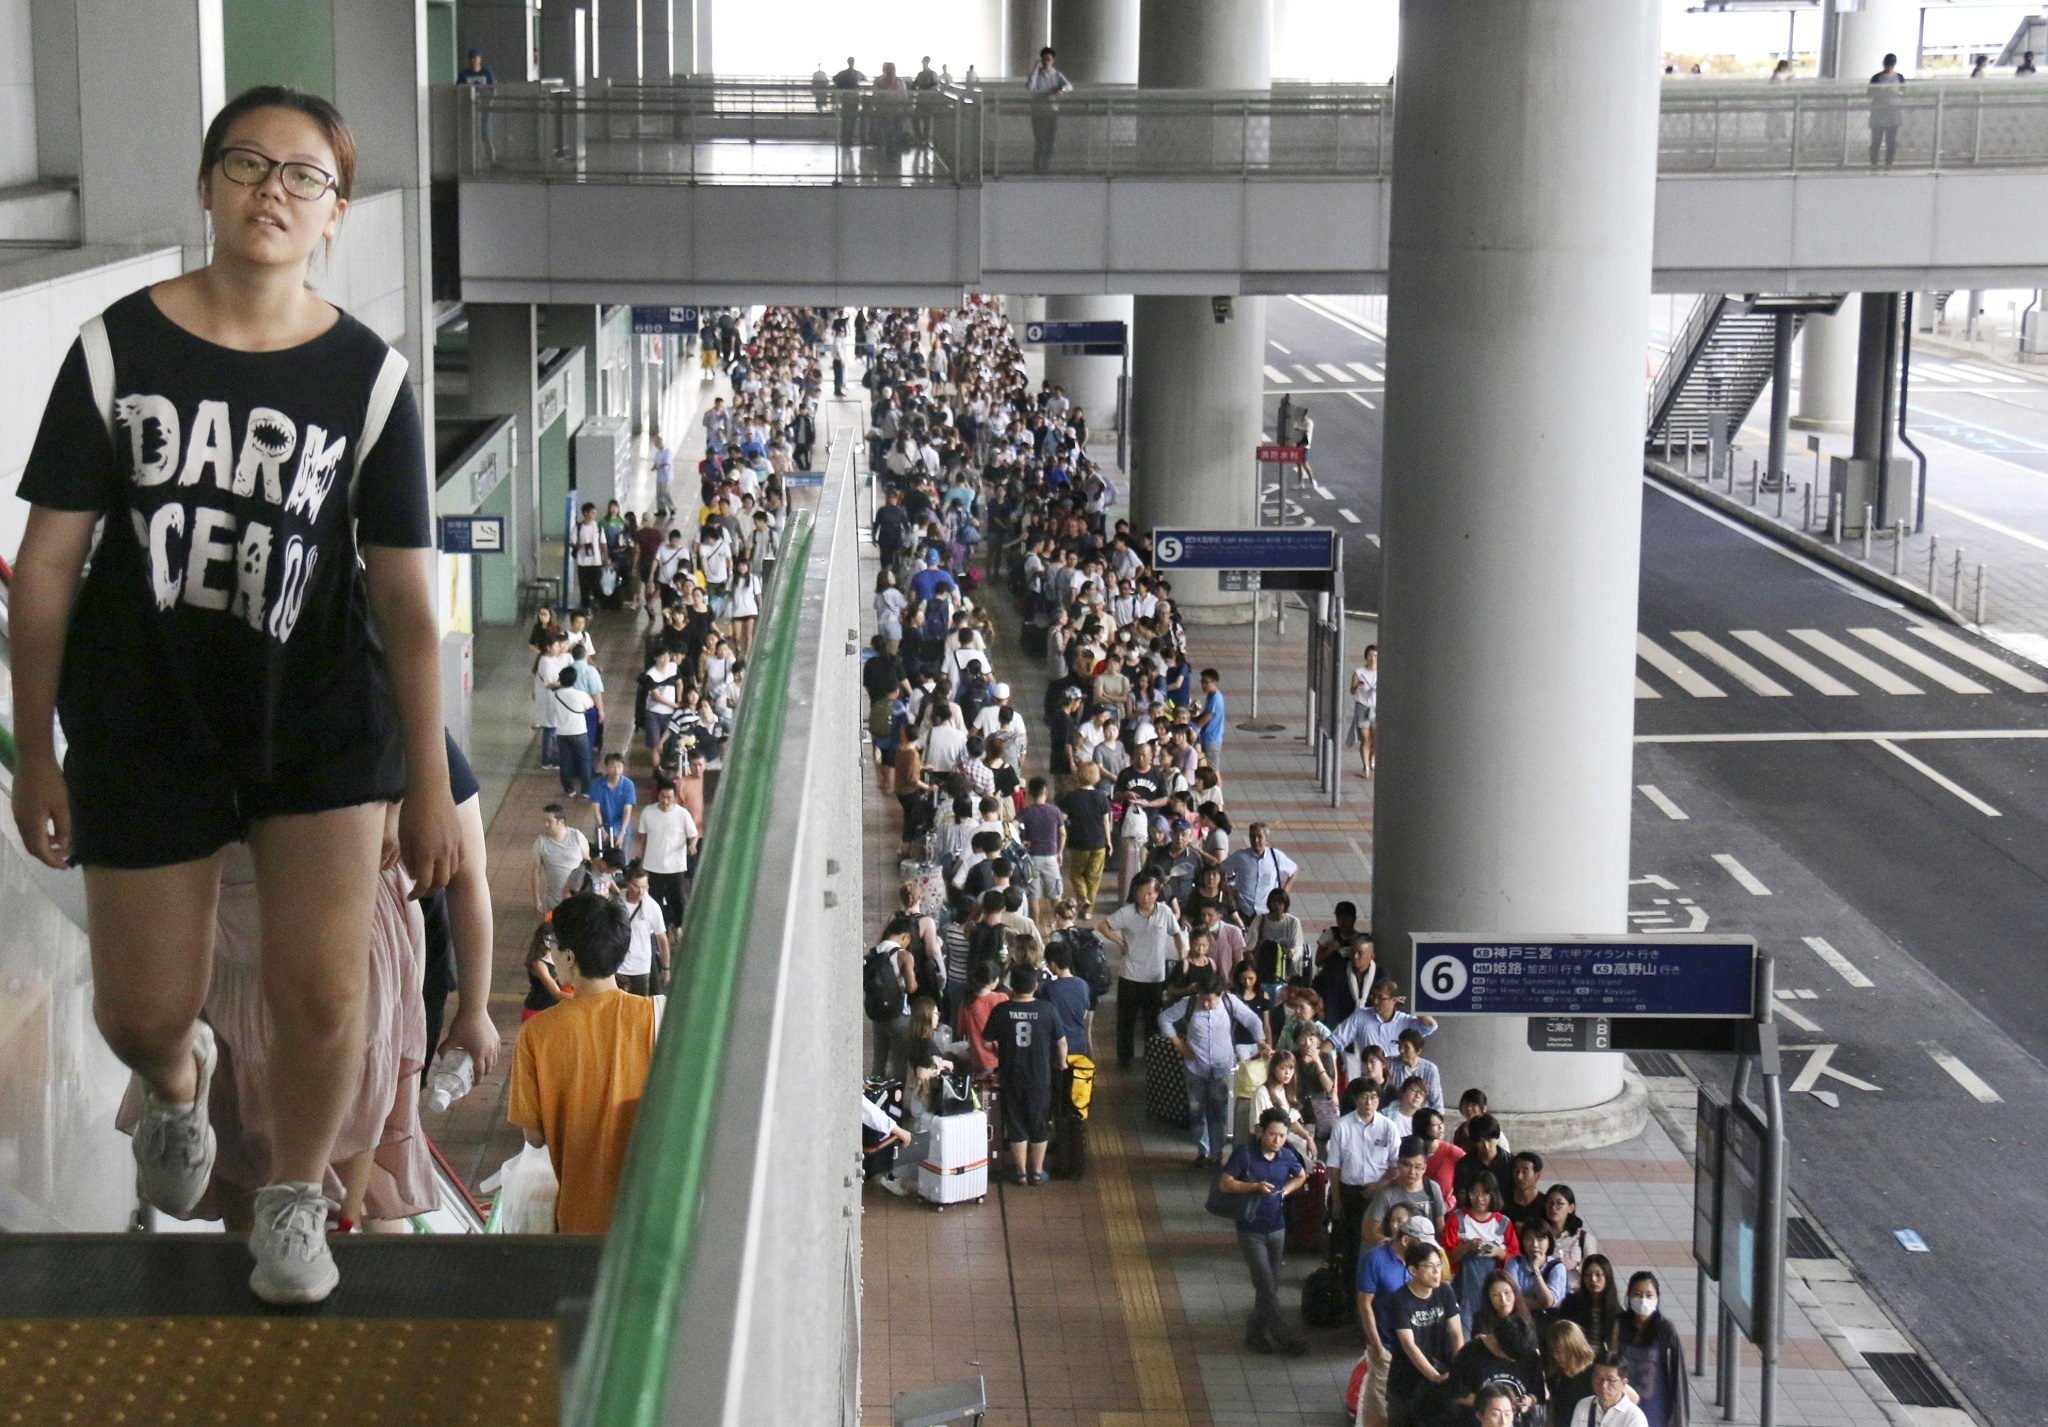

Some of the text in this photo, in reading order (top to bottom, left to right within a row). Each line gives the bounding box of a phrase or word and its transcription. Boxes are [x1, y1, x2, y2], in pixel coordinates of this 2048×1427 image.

[115, 393, 347, 525] DARK
[1164, 540, 1176, 558] 5
[1475, 949, 1491, 958] KB
[1475, 964, 1491, 974] HM
[1595, 965, 1611, 974] KS
[1432, 961, 1454, 994] 6
[1015, 1021, 1032, 1047] 8
[1546, 1023, 1574, 1033] ご案内
[1596, 1024, 1608, 1035] B
[1596, 1036, 1607, 1048] C
